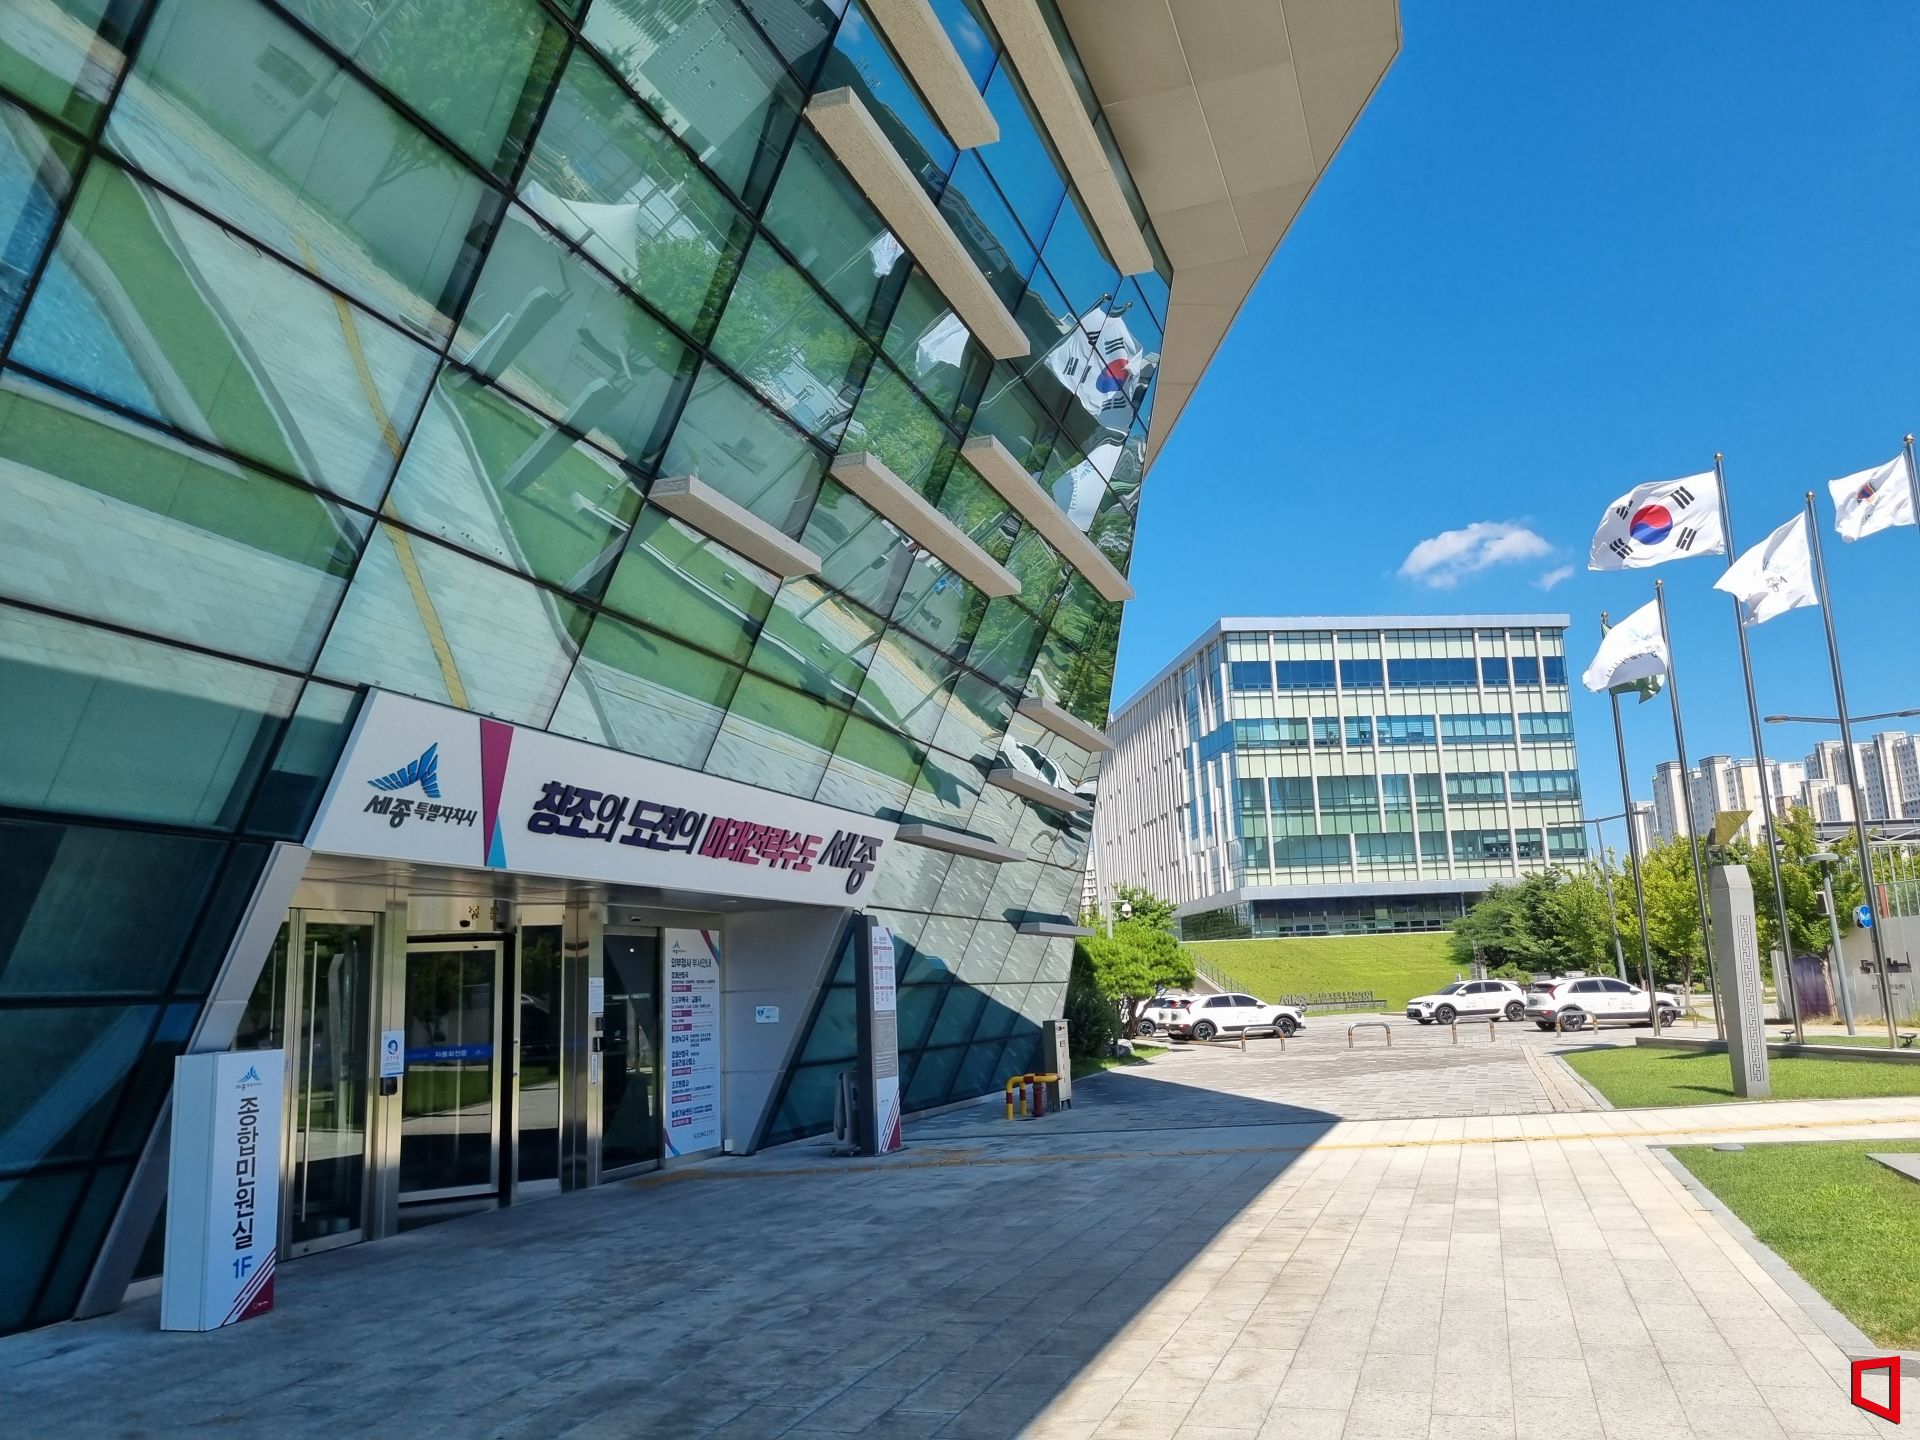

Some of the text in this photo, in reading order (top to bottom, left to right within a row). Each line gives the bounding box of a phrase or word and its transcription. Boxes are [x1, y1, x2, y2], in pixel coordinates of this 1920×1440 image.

[527, 781, 883, 895] 창조와 도전의 미래전략수도 세종
[232, 1096, 259, 1251] 종합민원실
[232, 1255, 253, 1279] 1F
